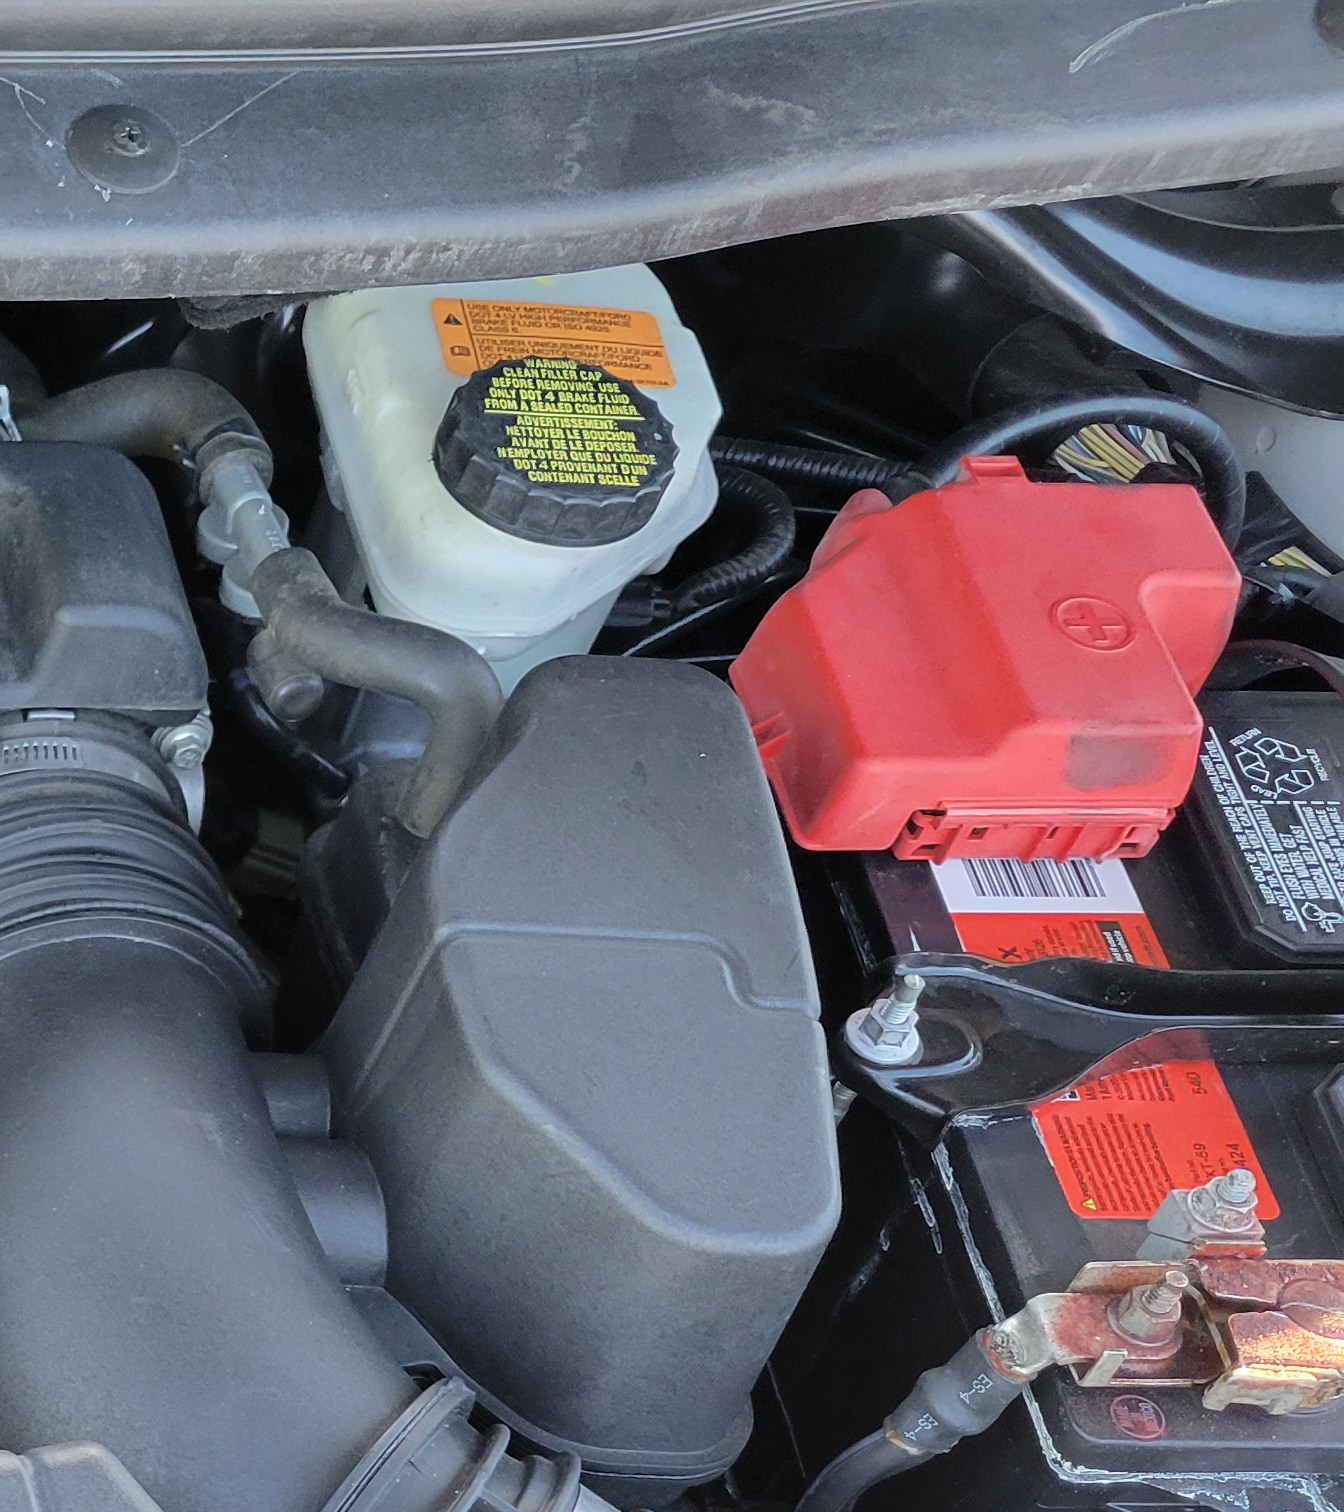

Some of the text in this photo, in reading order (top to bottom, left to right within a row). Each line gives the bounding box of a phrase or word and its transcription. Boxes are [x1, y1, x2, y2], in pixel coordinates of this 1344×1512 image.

[502, 367, 603, 381] CLEAN FILLER CAP
[491, 377, 535, 389] BEFORE
[597, 382, 621, 393] USE
[484, 398, 519, 411] FROM
[520, 400, 529, 411] A
[530, 401, 573, 414] SEALED
[488, 388, 630, 405] ONLY DOT 4 BRAKE FLUID
[516, 415, 619, 430] ADVERTISSEMENT:
[506, 426, 637, 442] NETTOYER LE BOUCHON
[511, 437, 550, 449] AVANT
[551, 439, 568, 450] DE
[568, 440, 585, 450] LE
[513, 459, 538, 471] DOT
[538, 461, 550, 471] 4
[550, 461, 619, 474] PROVENANT
[569, 451, 595, 462] QUE
[594, 452, 612, 463] DU
[612, 453, 658, 466] LIQUIDE
[527, 471, 596, 485] CONTENANT
[1229, 727, 1262, 748] RETURN
[1215, 762, 1231, 780] AND
[1216, 792, 1230, 806] OF
[1222, 779, 1241, 805] TIGHT
[1223, 805, 1244, 834] REACH
[1234, 805, 1252, 828] CAPS
[1302, 806, 1326, 841] STARTING
[1315, 807, 1337, 838] VEHICLE
[1235, 832, 1252, 852] THE
[1245, 829, 1263, 850] VENT
[1278, 832, 1297, 849] GET
[1243, 849, 1258, 863] OF
[1249, 802, 1307, 900] FLUSH EYES IMMEDIATELY
[1317, 840, 1337, 861] JUMP
[1250, 858, 1267, 883] OUT
[1255, 849, 1275, 873] KEEP
[1288, 824, 1336, 900] MEDICAL HELP FAST
[1258, 884, 1278, 905] KEEP
[1274, 891, 1291, 908] NOT
[1299, 879, 1321, 900] WITH
[1281, 908, 1298, 922] DO
[960, 1372, 993, 1407] ES-4
[903, 1410, 939, 1442] ES-4
